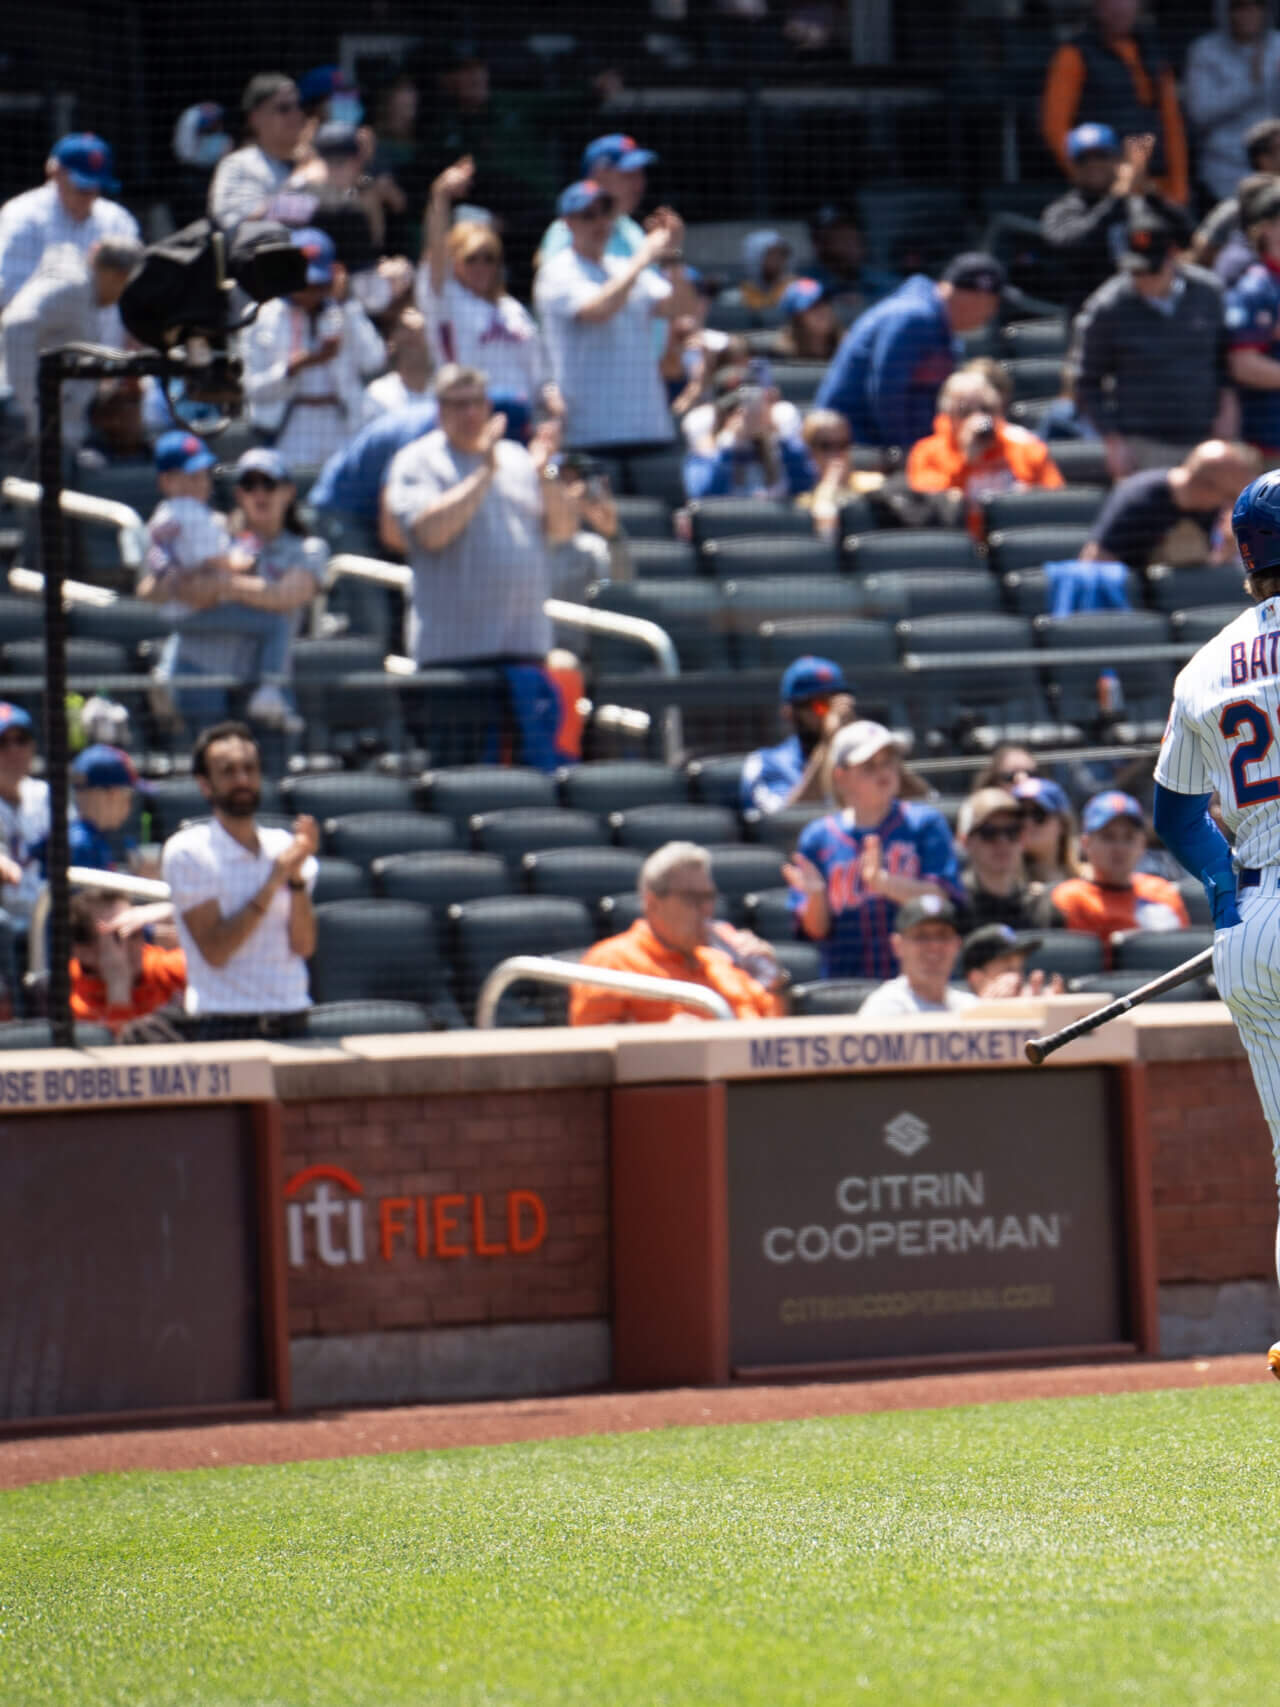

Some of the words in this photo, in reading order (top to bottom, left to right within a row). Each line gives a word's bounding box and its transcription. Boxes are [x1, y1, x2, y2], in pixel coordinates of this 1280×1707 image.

[44, 1065, 142, 1101] BOBBLE
[150, 1063, 200, 1095] MAY
[208, 1063, 231, 1094] 31
[836, 1172, 985, 1214] CITRIN
[380, 1189, 544, 1260] FIELD
[763, 1213, 1060, 1263] COOPERMAN
